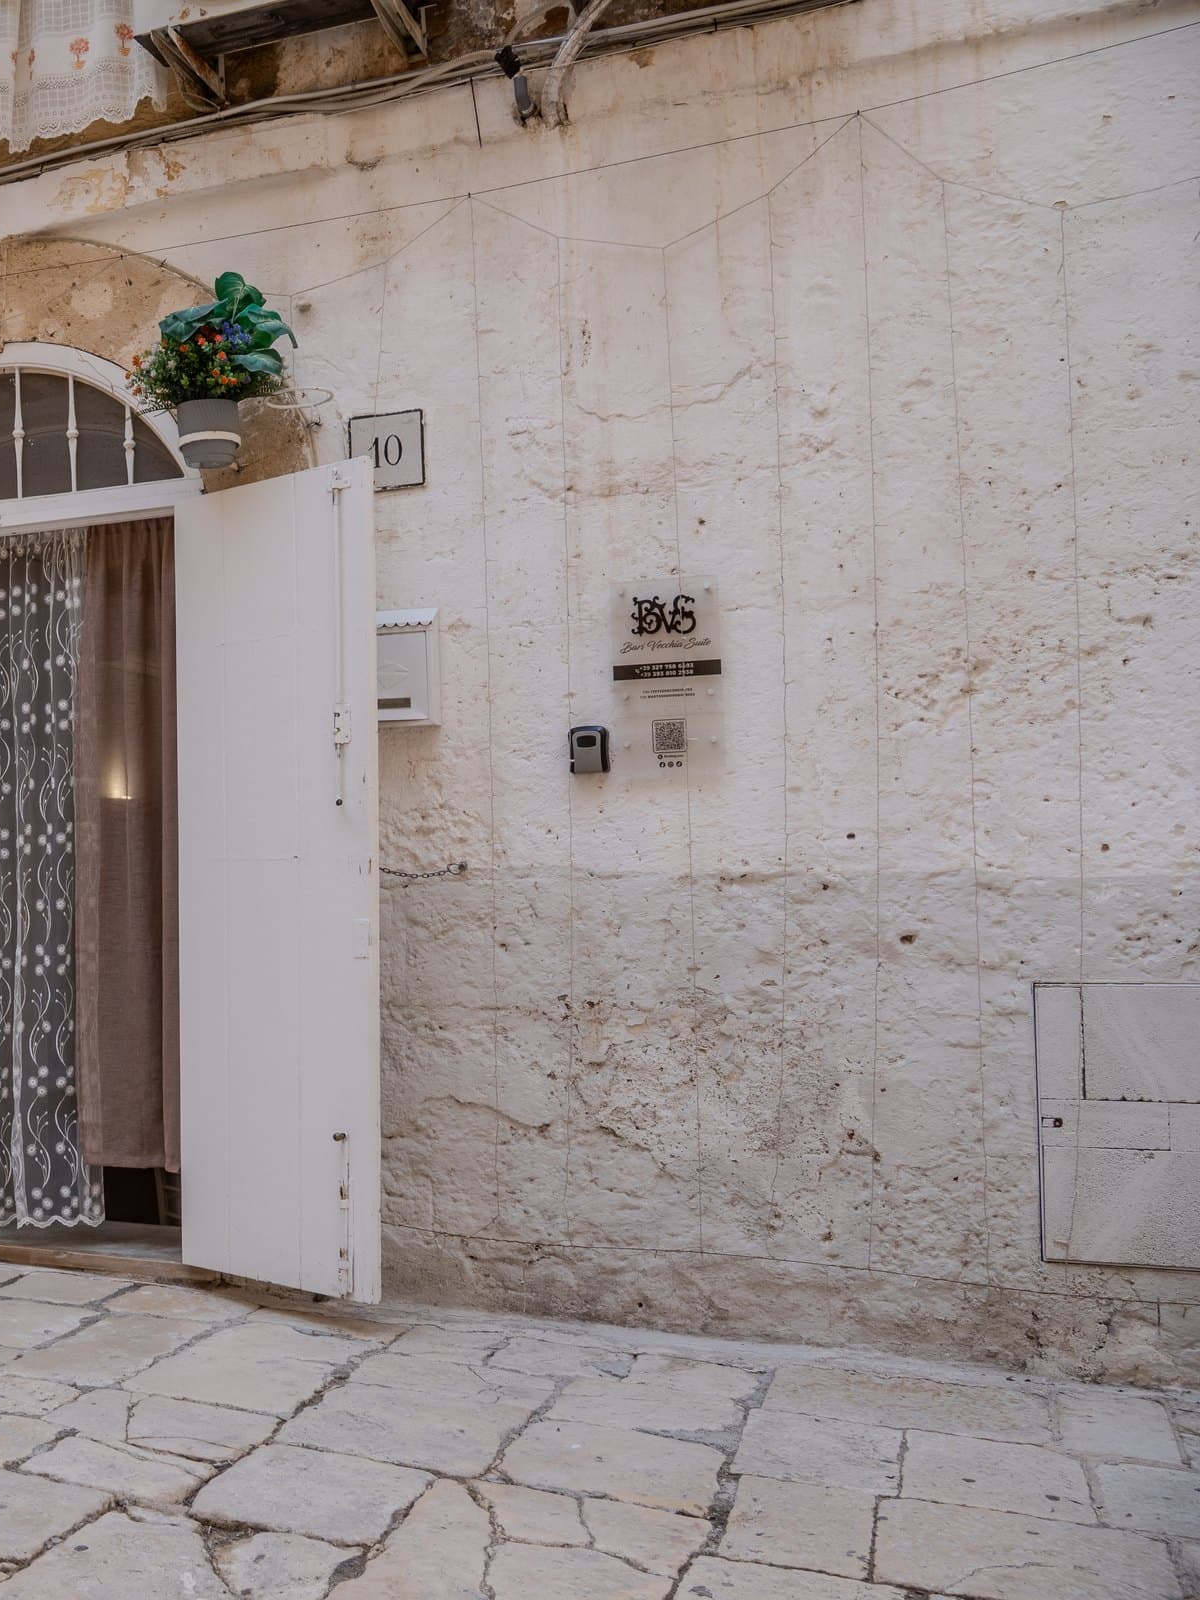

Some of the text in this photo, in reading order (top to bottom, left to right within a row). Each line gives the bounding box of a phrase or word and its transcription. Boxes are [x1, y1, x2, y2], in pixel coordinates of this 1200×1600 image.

[367, 434, 402, 468] 10
[631, 594, 696, 636] BVS
[620, 637, 711, 654] Bari Vecchia Suite
